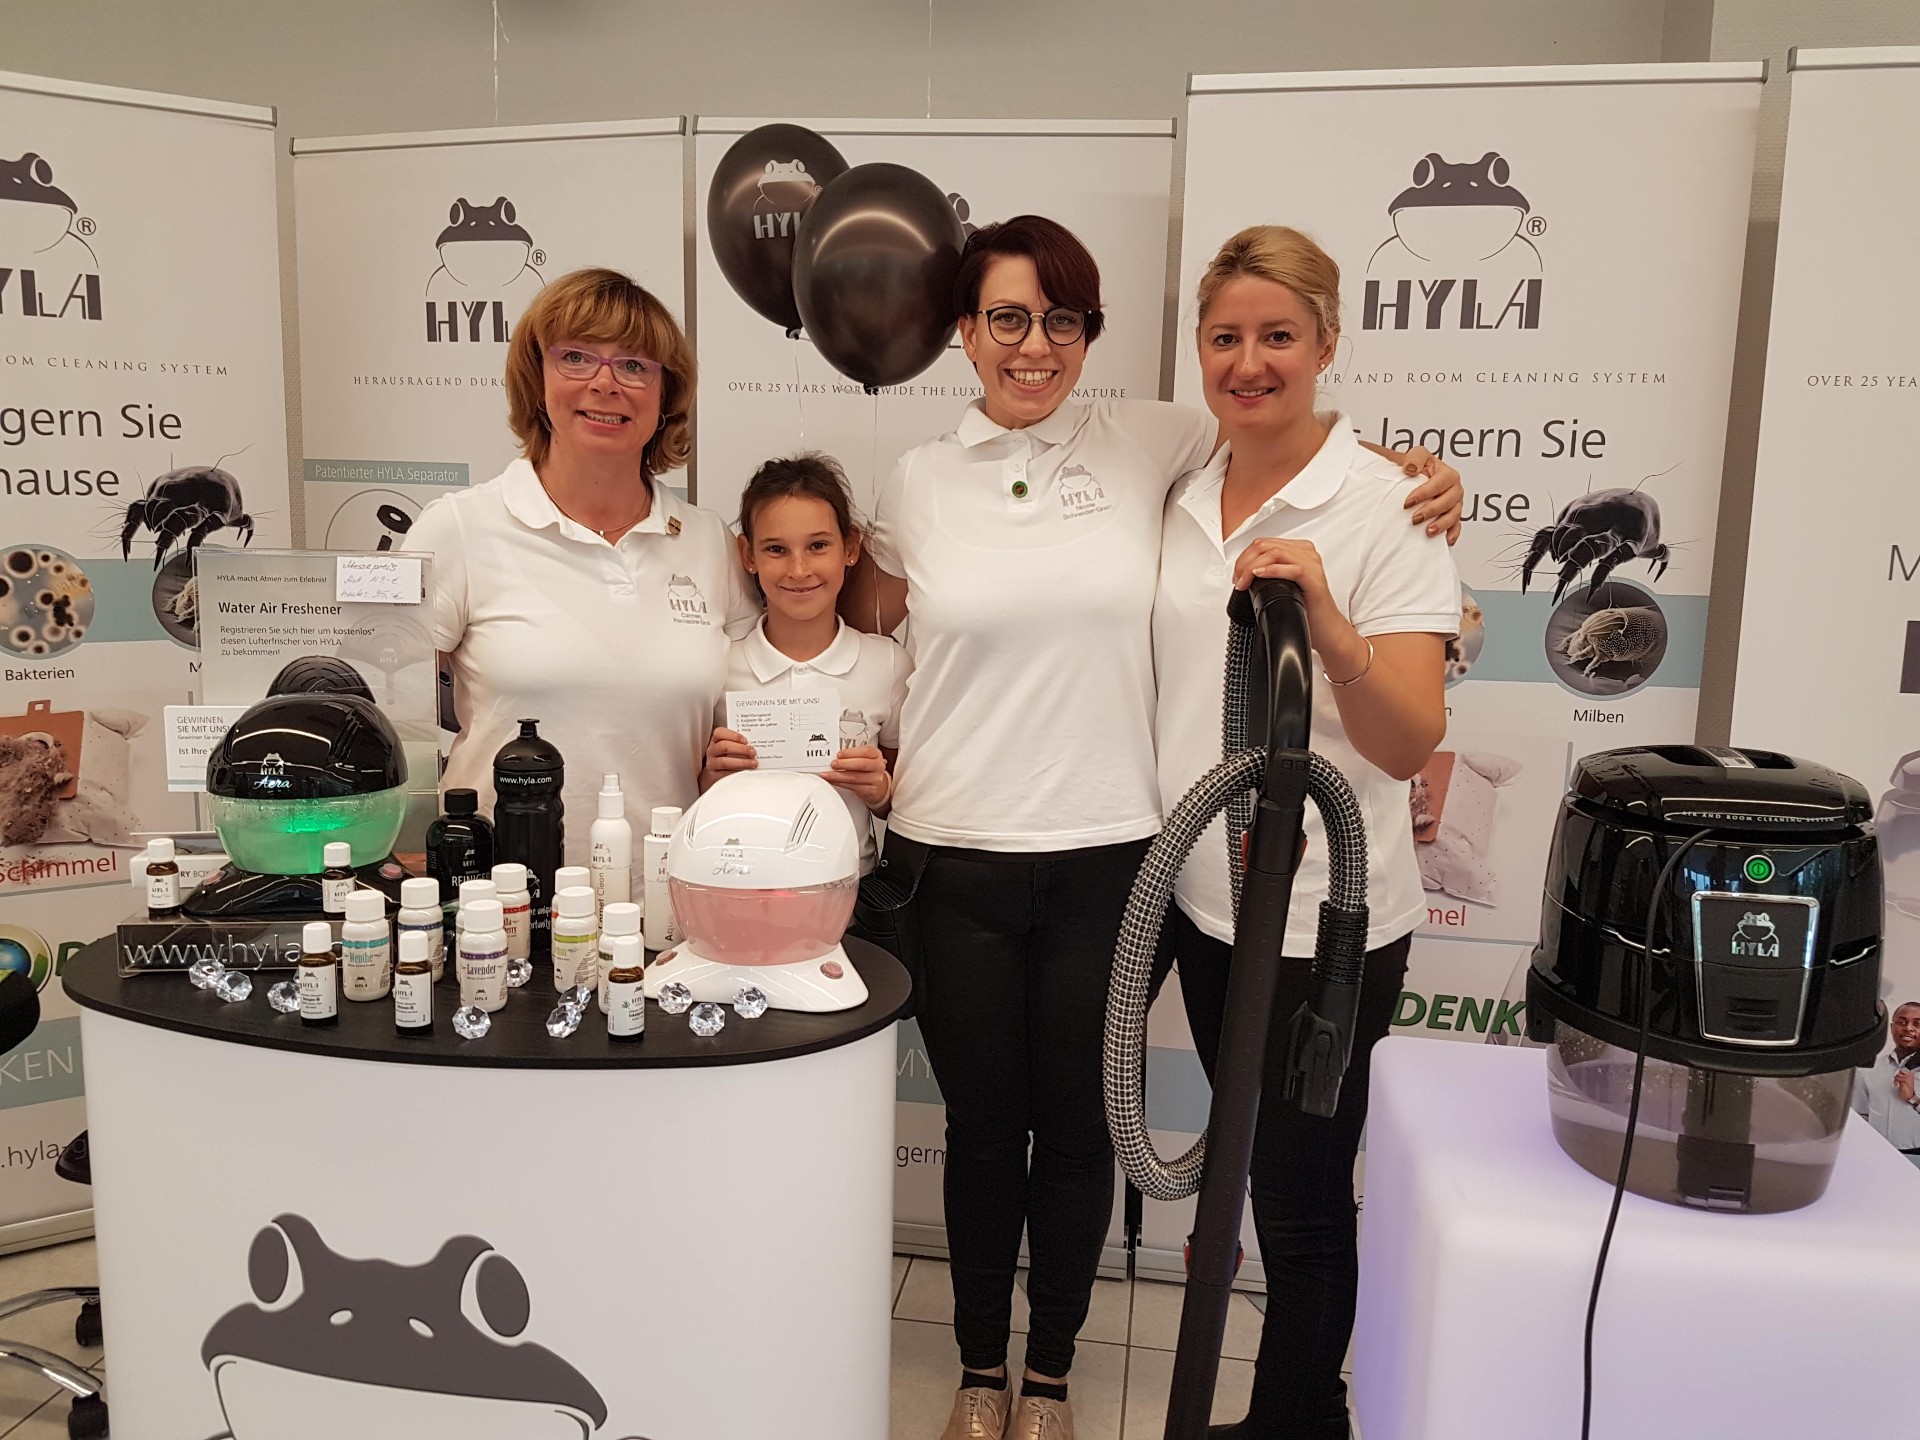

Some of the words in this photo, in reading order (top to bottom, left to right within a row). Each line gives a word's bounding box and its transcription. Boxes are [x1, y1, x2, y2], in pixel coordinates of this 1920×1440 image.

[1362, 279, 1543, 330] HYLA
[47, 357, 149, 372] CLEANING
[160, 363, 228, 376] SYSTEM
[353, 376, 462, 386] HERAUSRAGEND
[1354, 373, 1394, 383] AND
[1407, 372, 1463, 383] ROOM
[1476, 372, 1579, 383] CLEANING
[1592, 372, 1666, 383] SYSTEM
[1807, 375, 1853, 387] OVER
[1861, 376, 1879, 387] 25
[728, 382, 763, 392] OVER
[767, 383, 781, 393] 25
[920, 386, 946, 396] THE
[1071, 388, 1126, 398] NATURE
[121, 403, 182, 440] Sie
[1380, 417, 1521, 460] lagern
[1541, 419, 1606, 459] Sie
[315, 464, 373, 479] Patentierter
[377, 467, 404, 480] HYLA
[407, 467, 459, 483] Separator
[1060, 487, 1105, 507] HYLA
[259, 575, 282, 583] Atmen
[218, 602, 256, 614] Water
[259, 602, 278, 614] Air
[281, 602, 342, 615] Freshener
[669, 599, 707, 614] HYLA
[220, 626, 267, 636] Registrieren
[268, 626, 281, 635] Sie
[282, 626, 298, 635] sich
[300, 627, 315, 635] hier
[220, 637, 247, 645] diesen
[248, 637, 301, 646] Lufterfrischer
[320, 638, 342, 646] HYLA
[232, 648, 281, 656] bekommen!
[5, 667, 75, 681] Bakterien
[735, 699, 775, 707] GEWINNEN
[777, 698, 787, 706] SIE
[803, 697, 820, 705] UNS!
[177, 716, 224, 724] GEWINNEN
[1573, 709, 1624, 723] Milben
[177, 725, 189, 733] SIE
[191, 725, 207, 733] MIT
[178, 747, 189, 755] Ist
[191, 747, 208, 755] Ihre
[261, 767, 284, 775] HYLA
[500, 776, 553, 786] www.hyla.com
[1731, 941, 1779, 957] HYLA
[349, 952, 374, 963] Menthe
[466, 963, 496, 975] Lavender
